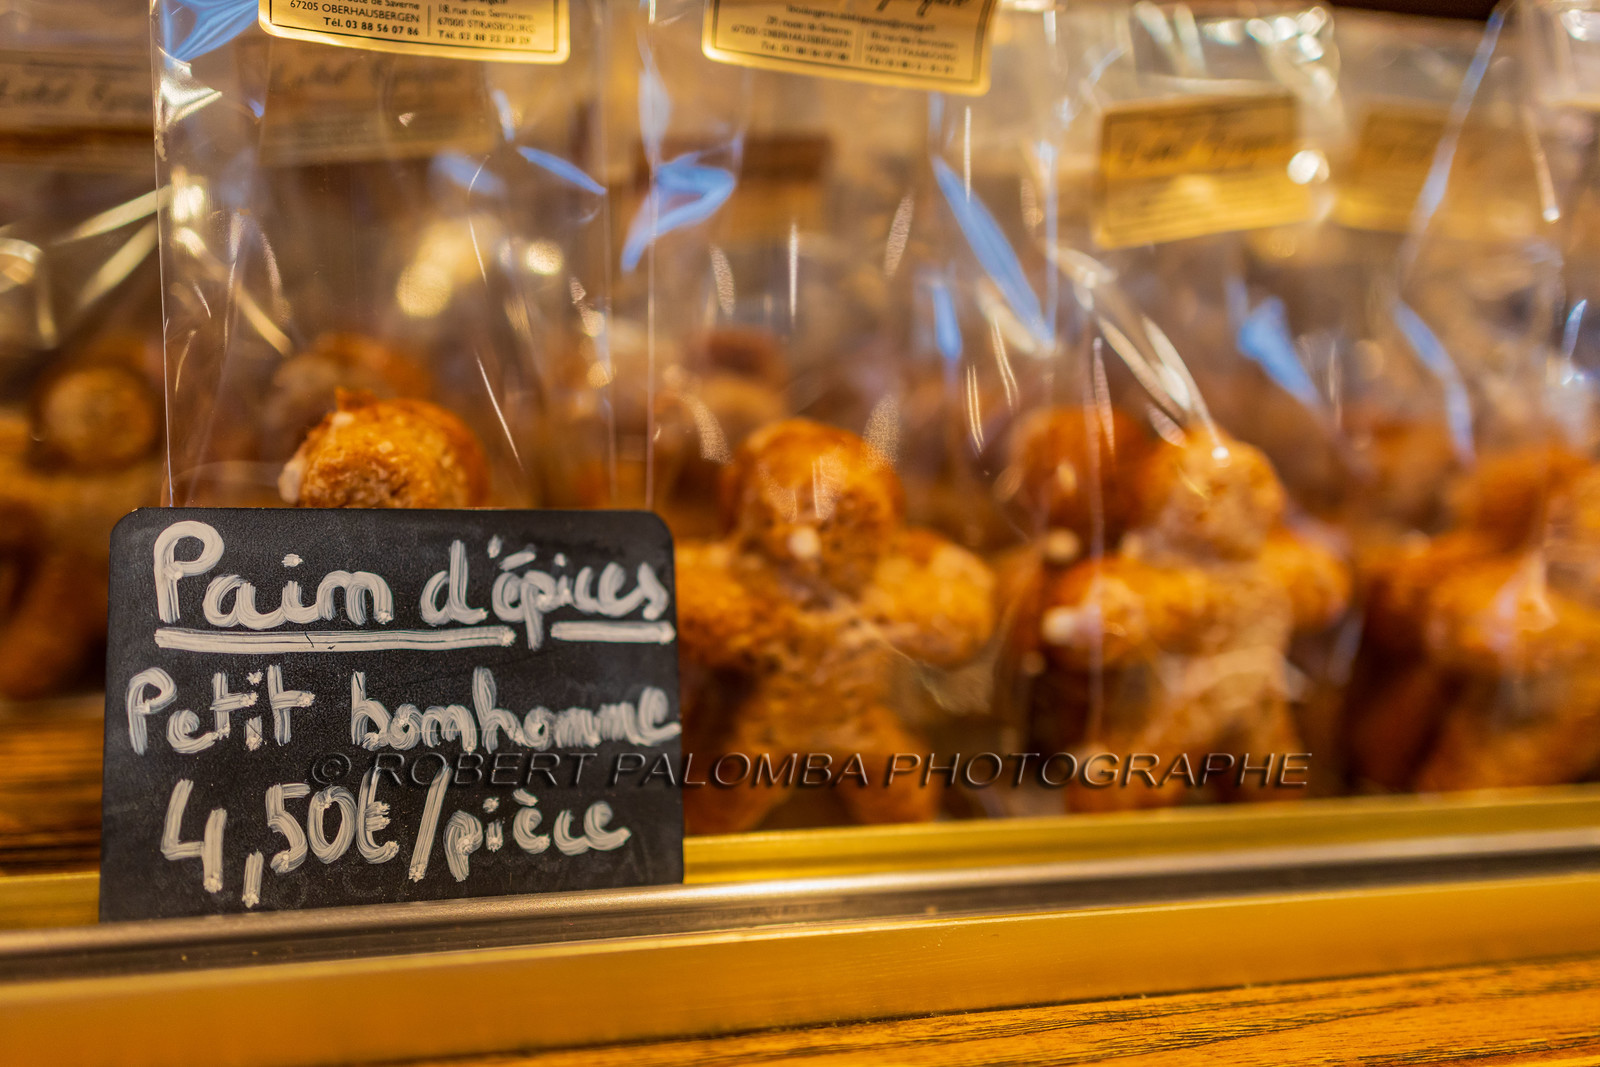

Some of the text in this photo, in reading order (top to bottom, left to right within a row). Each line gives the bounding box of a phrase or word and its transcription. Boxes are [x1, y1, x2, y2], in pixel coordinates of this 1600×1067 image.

[290, 1, 420, 23] 67205 OBERHAUSBERGEN
[323, 16, 344, 28] Tél.
[345, 19, 358, 29] 03
[361, 21, 374, 31] 88
[376, 23, 389, 33] 56
[391, 24, 404, 34] 07
[153, 519, 670, 651] Pain d'épices
[125, 663, 682, 756] Petit bonhomme
